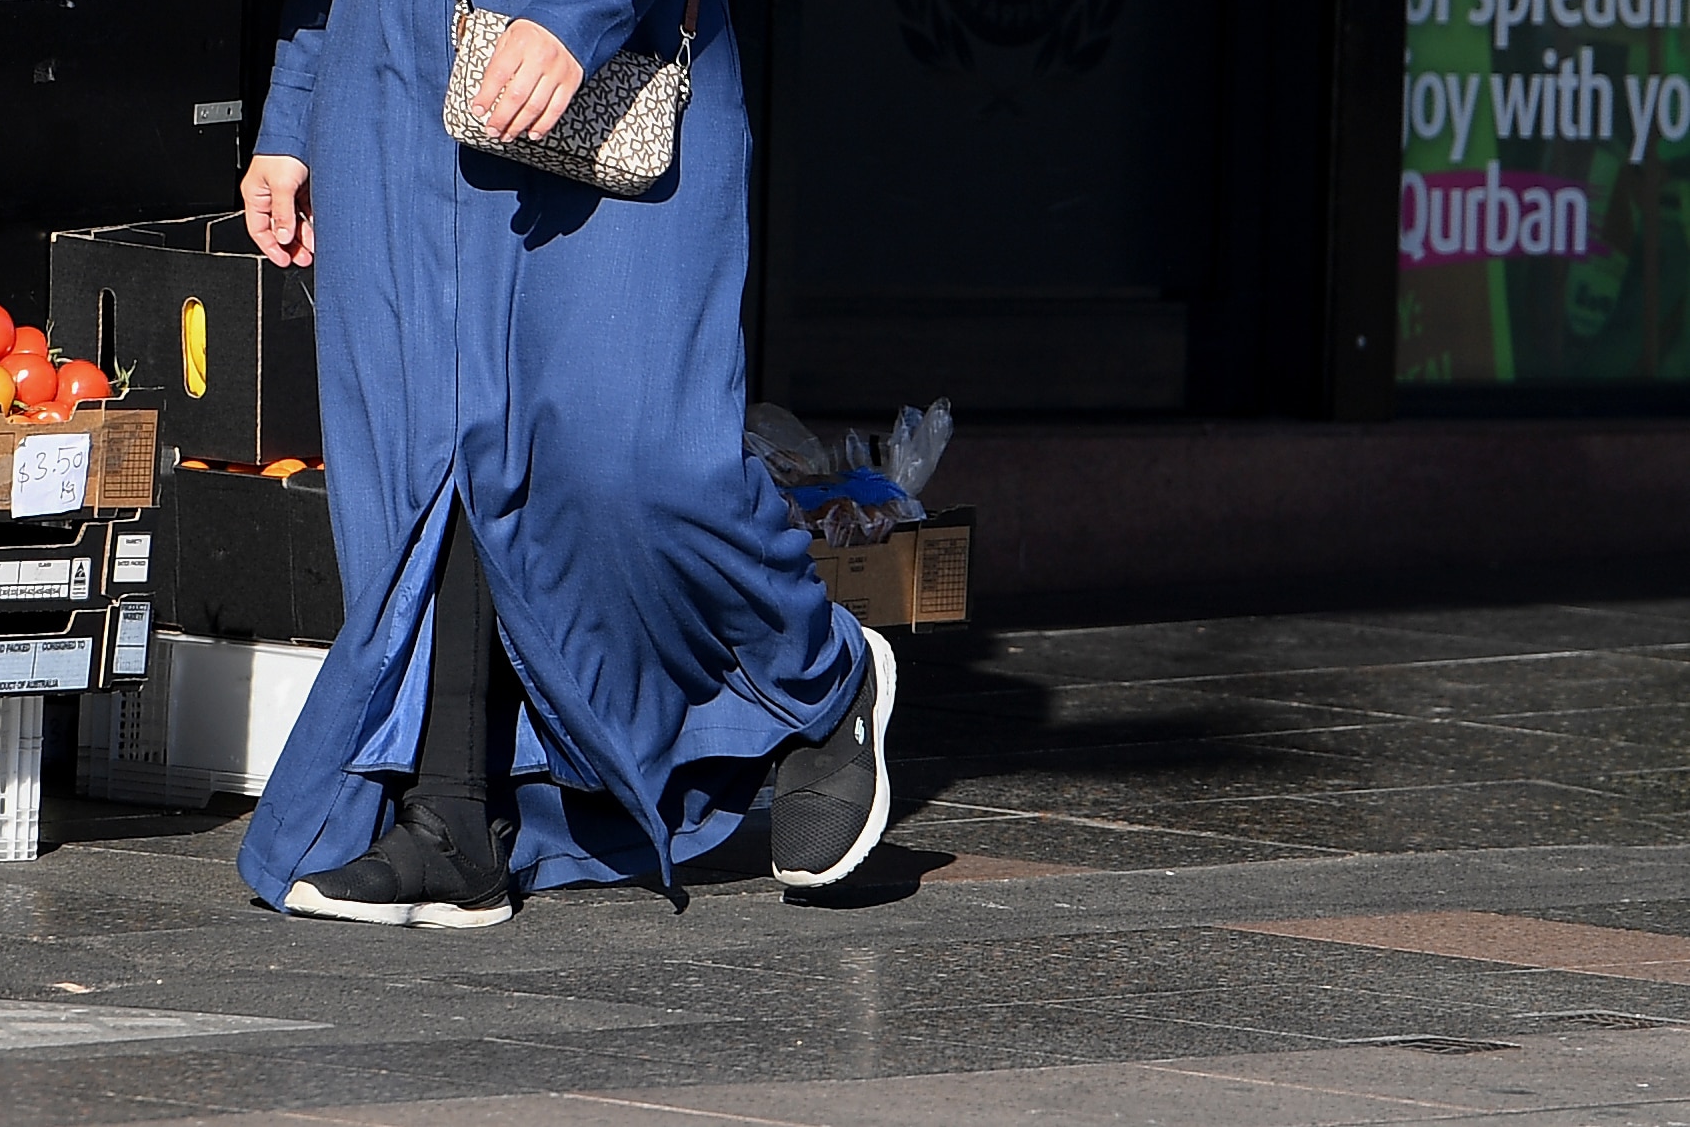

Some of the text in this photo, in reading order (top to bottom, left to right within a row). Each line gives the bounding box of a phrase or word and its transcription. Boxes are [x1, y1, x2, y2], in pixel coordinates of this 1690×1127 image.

[1491, 46, 1614, 141] with
[1400, 159, 1589, 262] Qurban
[18, 447, 83, 493] $3.50
[16, 681, 25, 690] OF
[25, 679, 58, 689] AUSTRALIA
